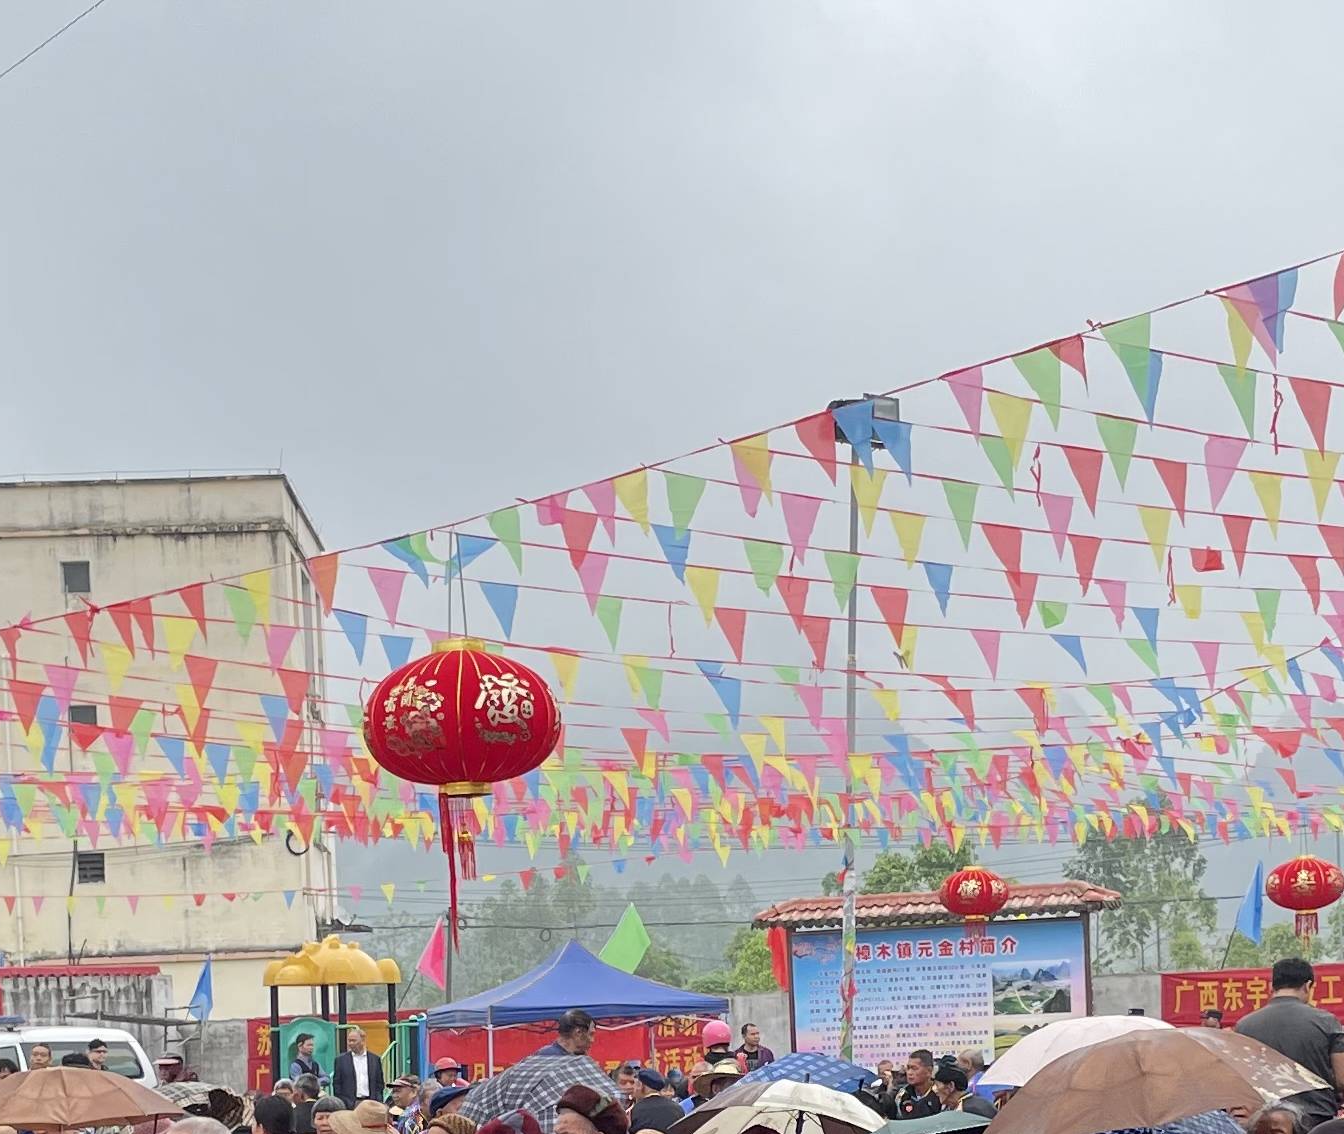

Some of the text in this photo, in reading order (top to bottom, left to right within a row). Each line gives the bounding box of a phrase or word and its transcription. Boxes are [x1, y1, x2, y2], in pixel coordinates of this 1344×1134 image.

[855, 936, 1017, 962] 樟木镇元金村简介
